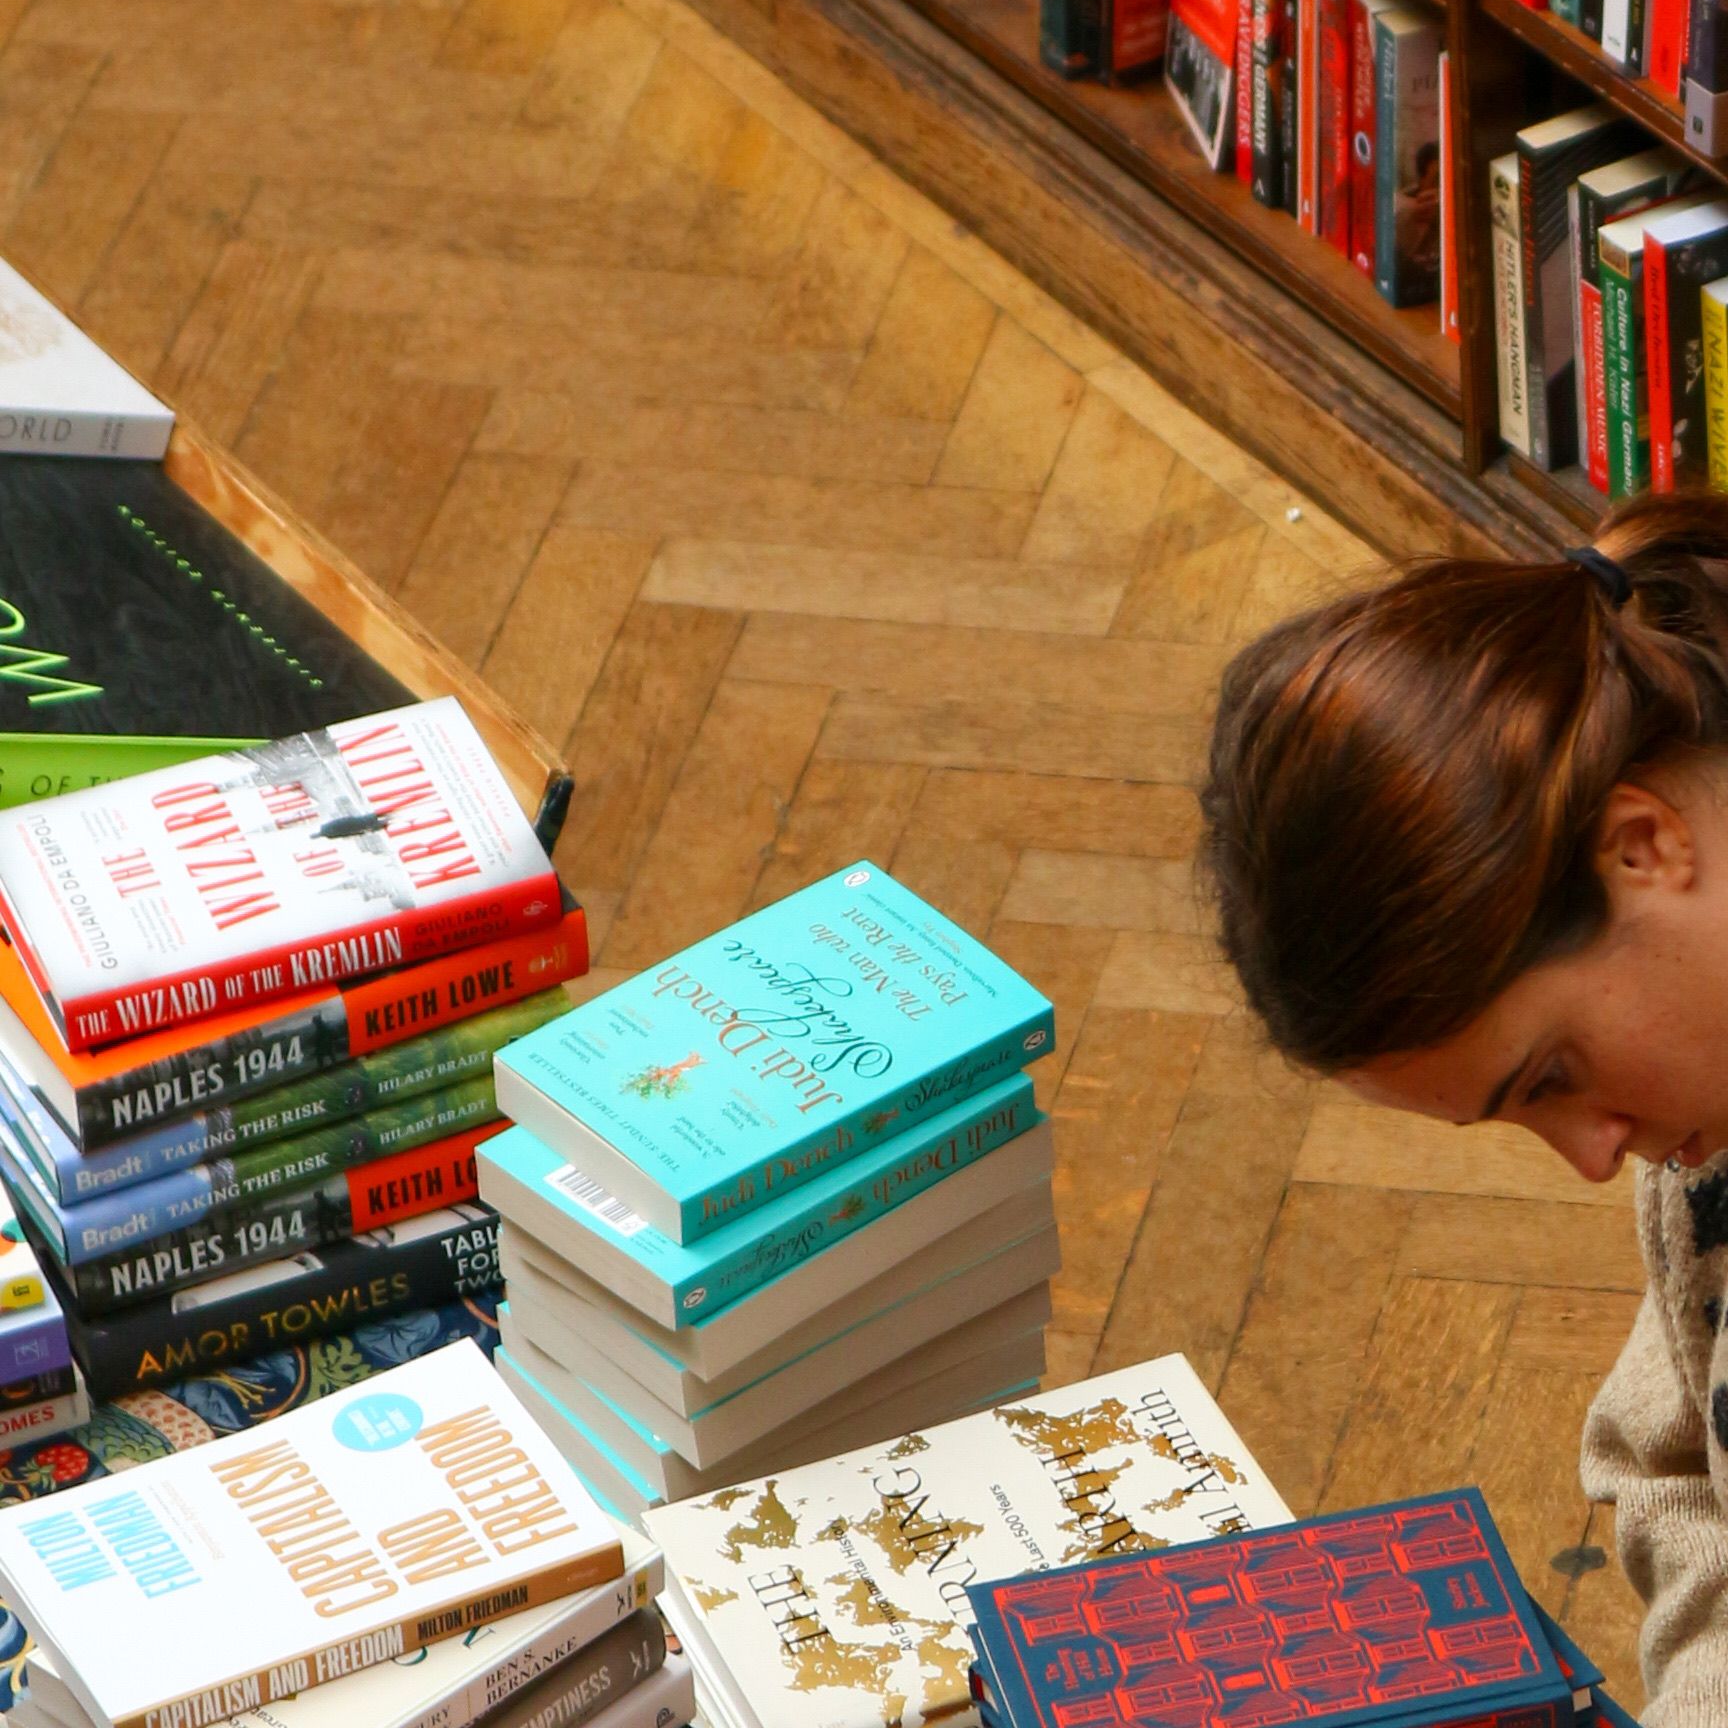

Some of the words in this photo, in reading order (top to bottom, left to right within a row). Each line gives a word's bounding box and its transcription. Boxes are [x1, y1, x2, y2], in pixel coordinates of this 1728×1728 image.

[1708, 326, 1726, 398] NAZI
[259, 781, 319, 829] THE
[338, 722, 482, 889] KREMLIN
[102, 847, 162, 898] THE
[152, 781, 281, 930] WIZARD
[293, 849, 345, 878] OF
[808, 922, 849, 956] who
[841, 906, 887, 939] Rent
[887, 941, 930, 976] the
[76, 1012, 109, 1037] THE
[116, 979, 217, 1033] WIZARD
[225, 977, 246, 998] OF
[250, 965, 284, 993] THE
[288, 926, 402, 987] KREMLIN
[650, 965, 760, 1058] Dench
[724, 939, 893, 1078] Shakespeare
[853, 956, 899, 993] Man
[893, 988, 934, 1021] The
[918, 967, 968, 1007] Pays
[112, 1062, 225, 1128] NAPLES
[234, 1036, 304, 1084] 1944
[366, 991, 439, 1037] KEITH
[449, 961, 515, 1008] LOWE
[751, 1058, 843, 1115] Judi
[75, 1157, 144, 1191] Bradt
[161, 1129, 236, 1162] TAKING
[240, 1116, 277, 1140] THE
[280, 1100, 326, 1128] RISK
[377, 1066, 435, 1094] HILARY
[438, 1050, 488, 1074] BRADT
[137, 1323, 249, 1377] AMOR
[260, 1272, 410, 1339] TOWLES
[414, 1406, 578, 1556] FREEDOM
[18, 1511, 118, 1592] MILTON
[82, 1491, 202, 1598] FRIEDMAN
[209, 1438, 399, 1618] CAPITALISM
[376, 1508, 491, 1586] AND
[270, 1663, 308, 1700] AND
[316, 1624, 402, 1684] FREEDOM
[416, 1607, 462, 1640] MILTON
[466, 1586, 528, 1626] FRIEDMAN
